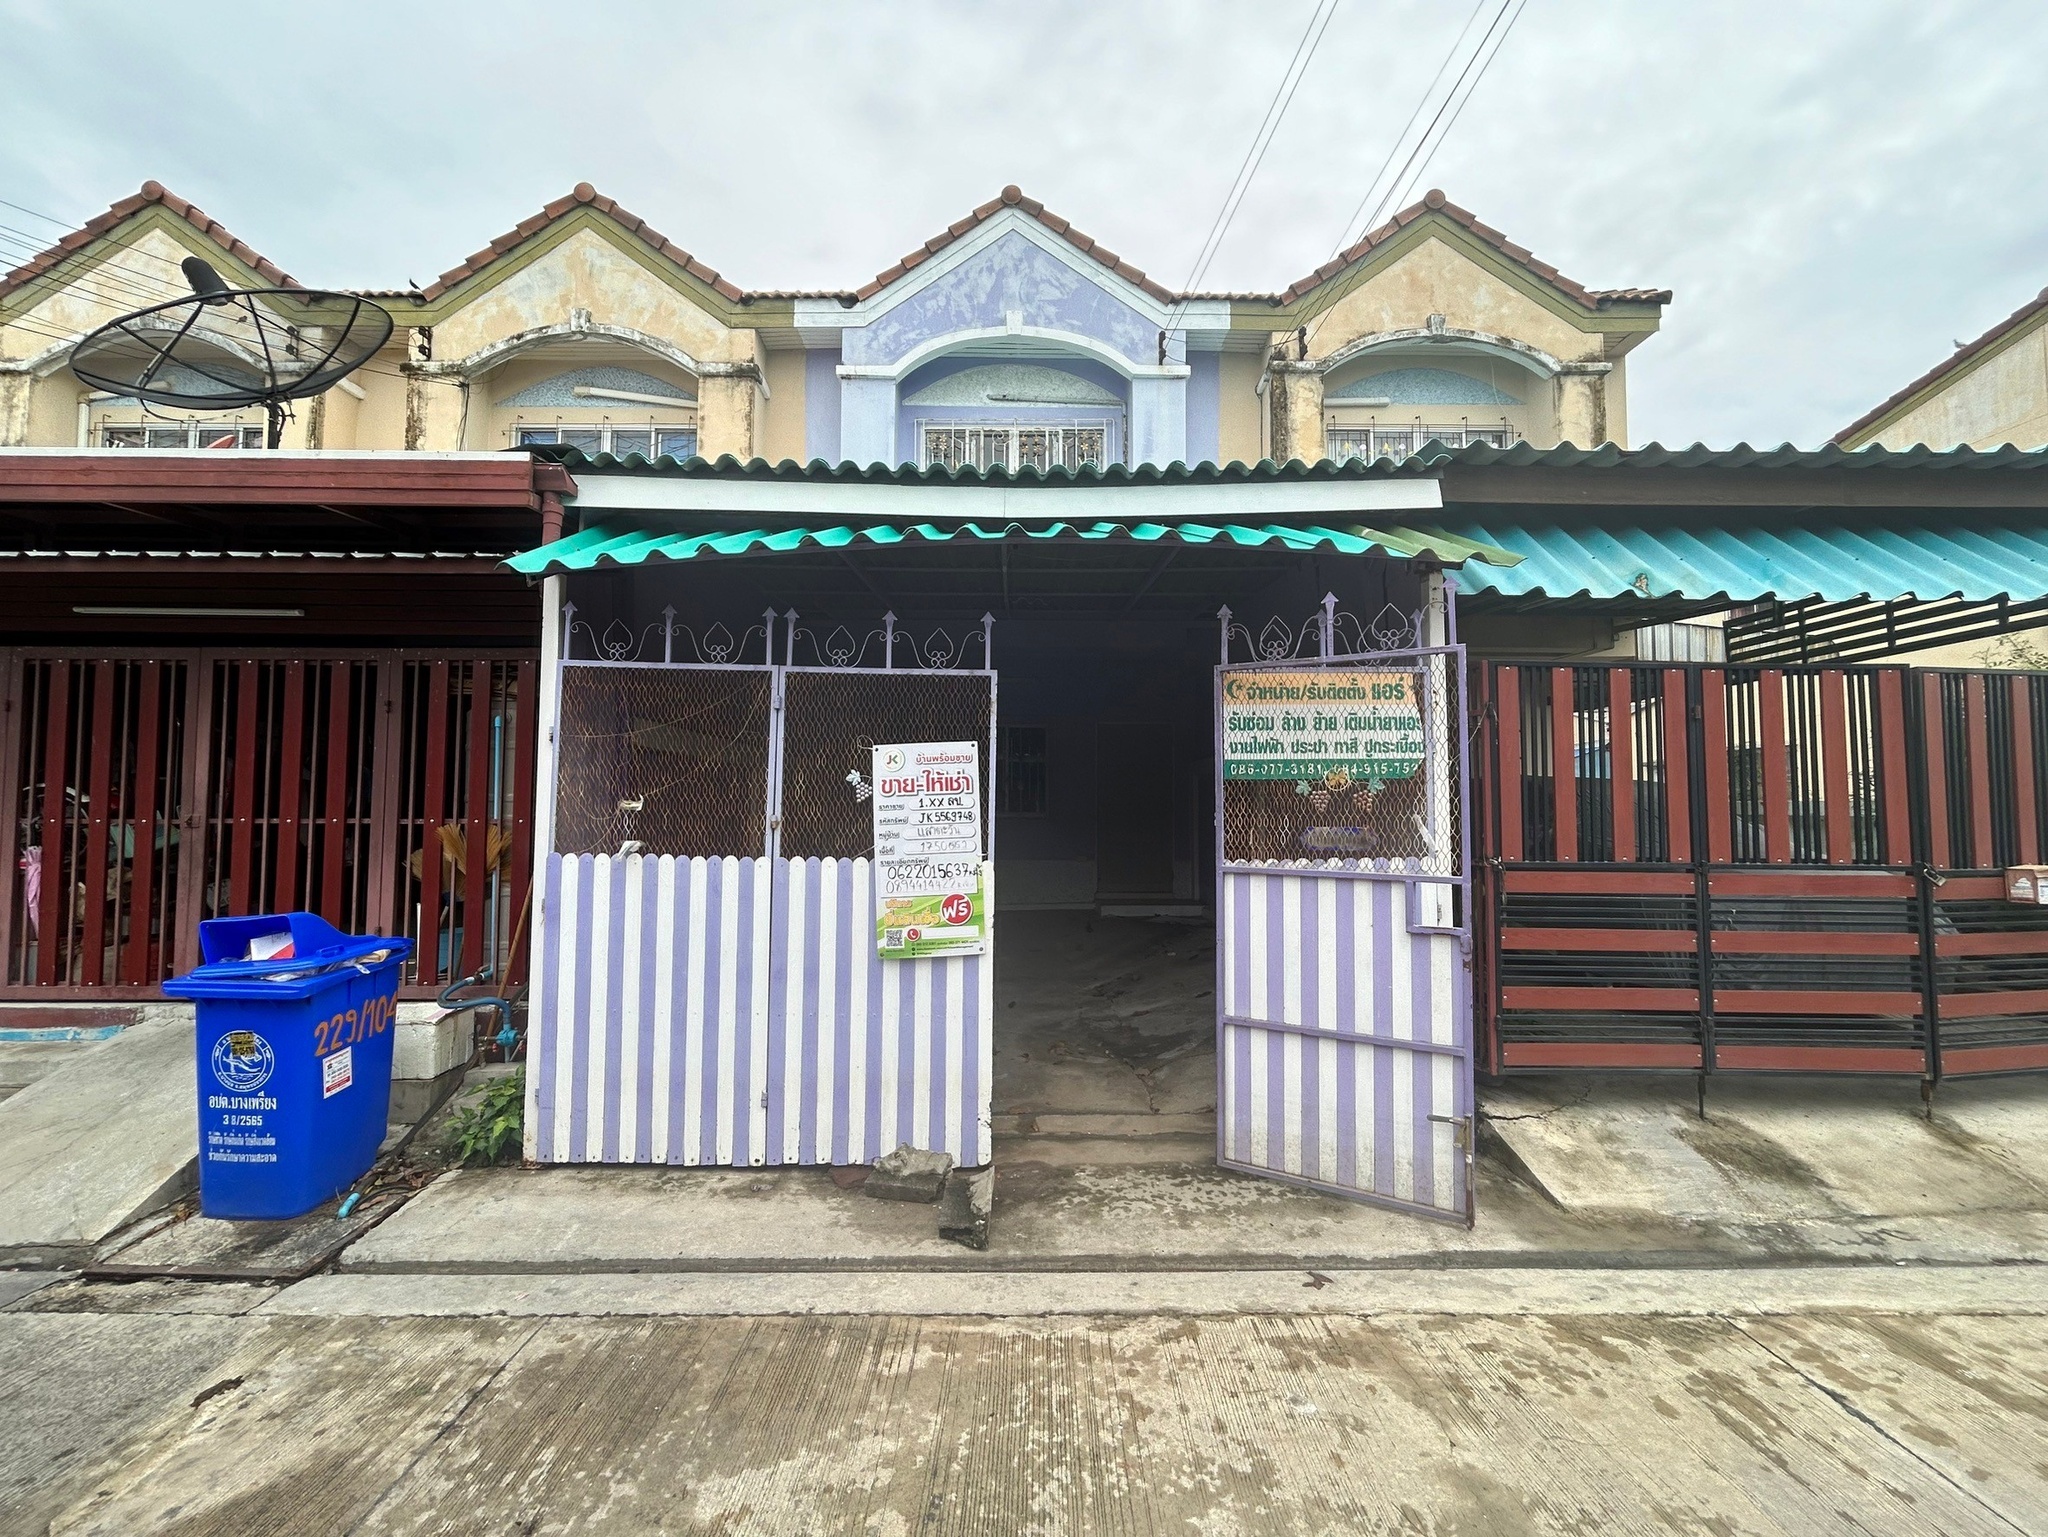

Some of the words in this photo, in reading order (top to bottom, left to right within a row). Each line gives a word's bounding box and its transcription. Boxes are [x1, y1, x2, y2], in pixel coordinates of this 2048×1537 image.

[1371, 677, 1405, 701] แอร์
[1228, 711, 1275, 731] รับซ่อม
[1281, 711, 1306, 731] ล้าง
[1313, 711, 1338, 731] ย้าย
[1229, 736, 1285, 754] งานไฟฟ้า
[1291, 738, 1328, 754] ประปา
[1335, 736, 1359, 754] ทาสี
[886, 754, 899, 765] JK
[915, 752, 973, 764] บ้านพร้อมขาย
[880, 769, 971, 795] ขาย-ให้เช่า
[943, 897, 969, 919] ฟรี
[208, 1090, 277, 1110] อบต.บางเพรียง
